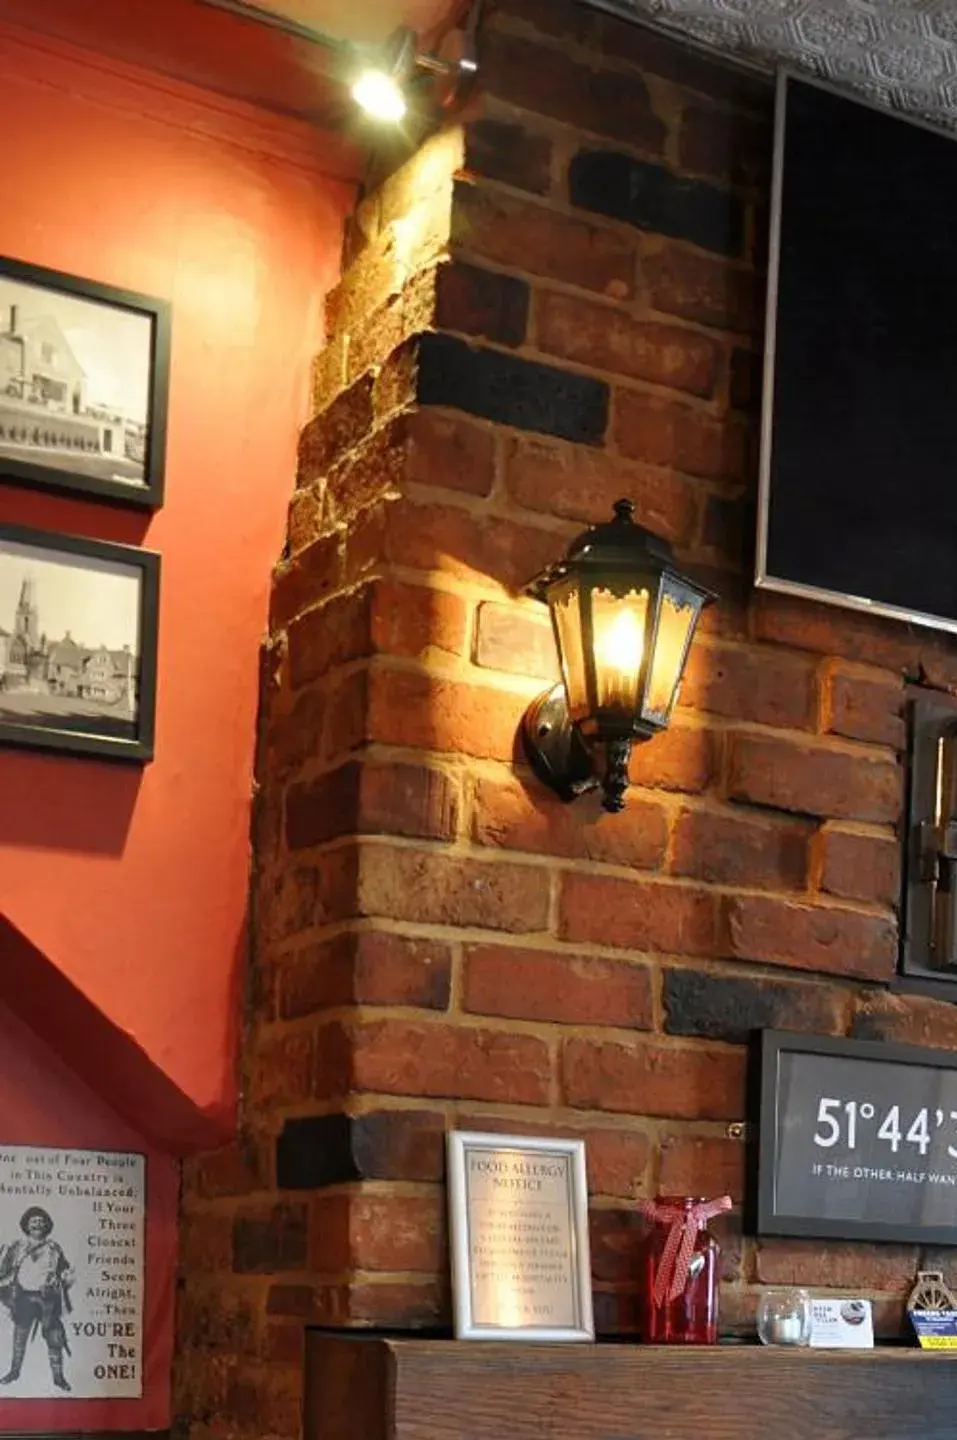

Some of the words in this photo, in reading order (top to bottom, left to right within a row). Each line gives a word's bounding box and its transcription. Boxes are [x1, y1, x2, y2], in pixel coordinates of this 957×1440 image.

[96, 1155, 137, 1169] People
[512, 1161, 566, 1178] ALLERGY
[812, 1164, 823, 1177] IF
[826, 1165, 850, 1178] THE
[853, 1167, 893, 1181] OTHER
[897, 1172, 926, 1184] HALF
[57, 1170, 109, 1184] Country
[494, 1178, 542, 1192] NOTICE
[105, 1201, 135, 1214] Your
[99, 1218, 136, 1230] Three
[87, 1235, 136, 1248] Closest
[87, 1254, 136, 1266] Friends
[101, 1271, 136, 1282] Seem
[107, 1344, 136, 1358] The
[93, 1365, 136, 1380] ONE!
